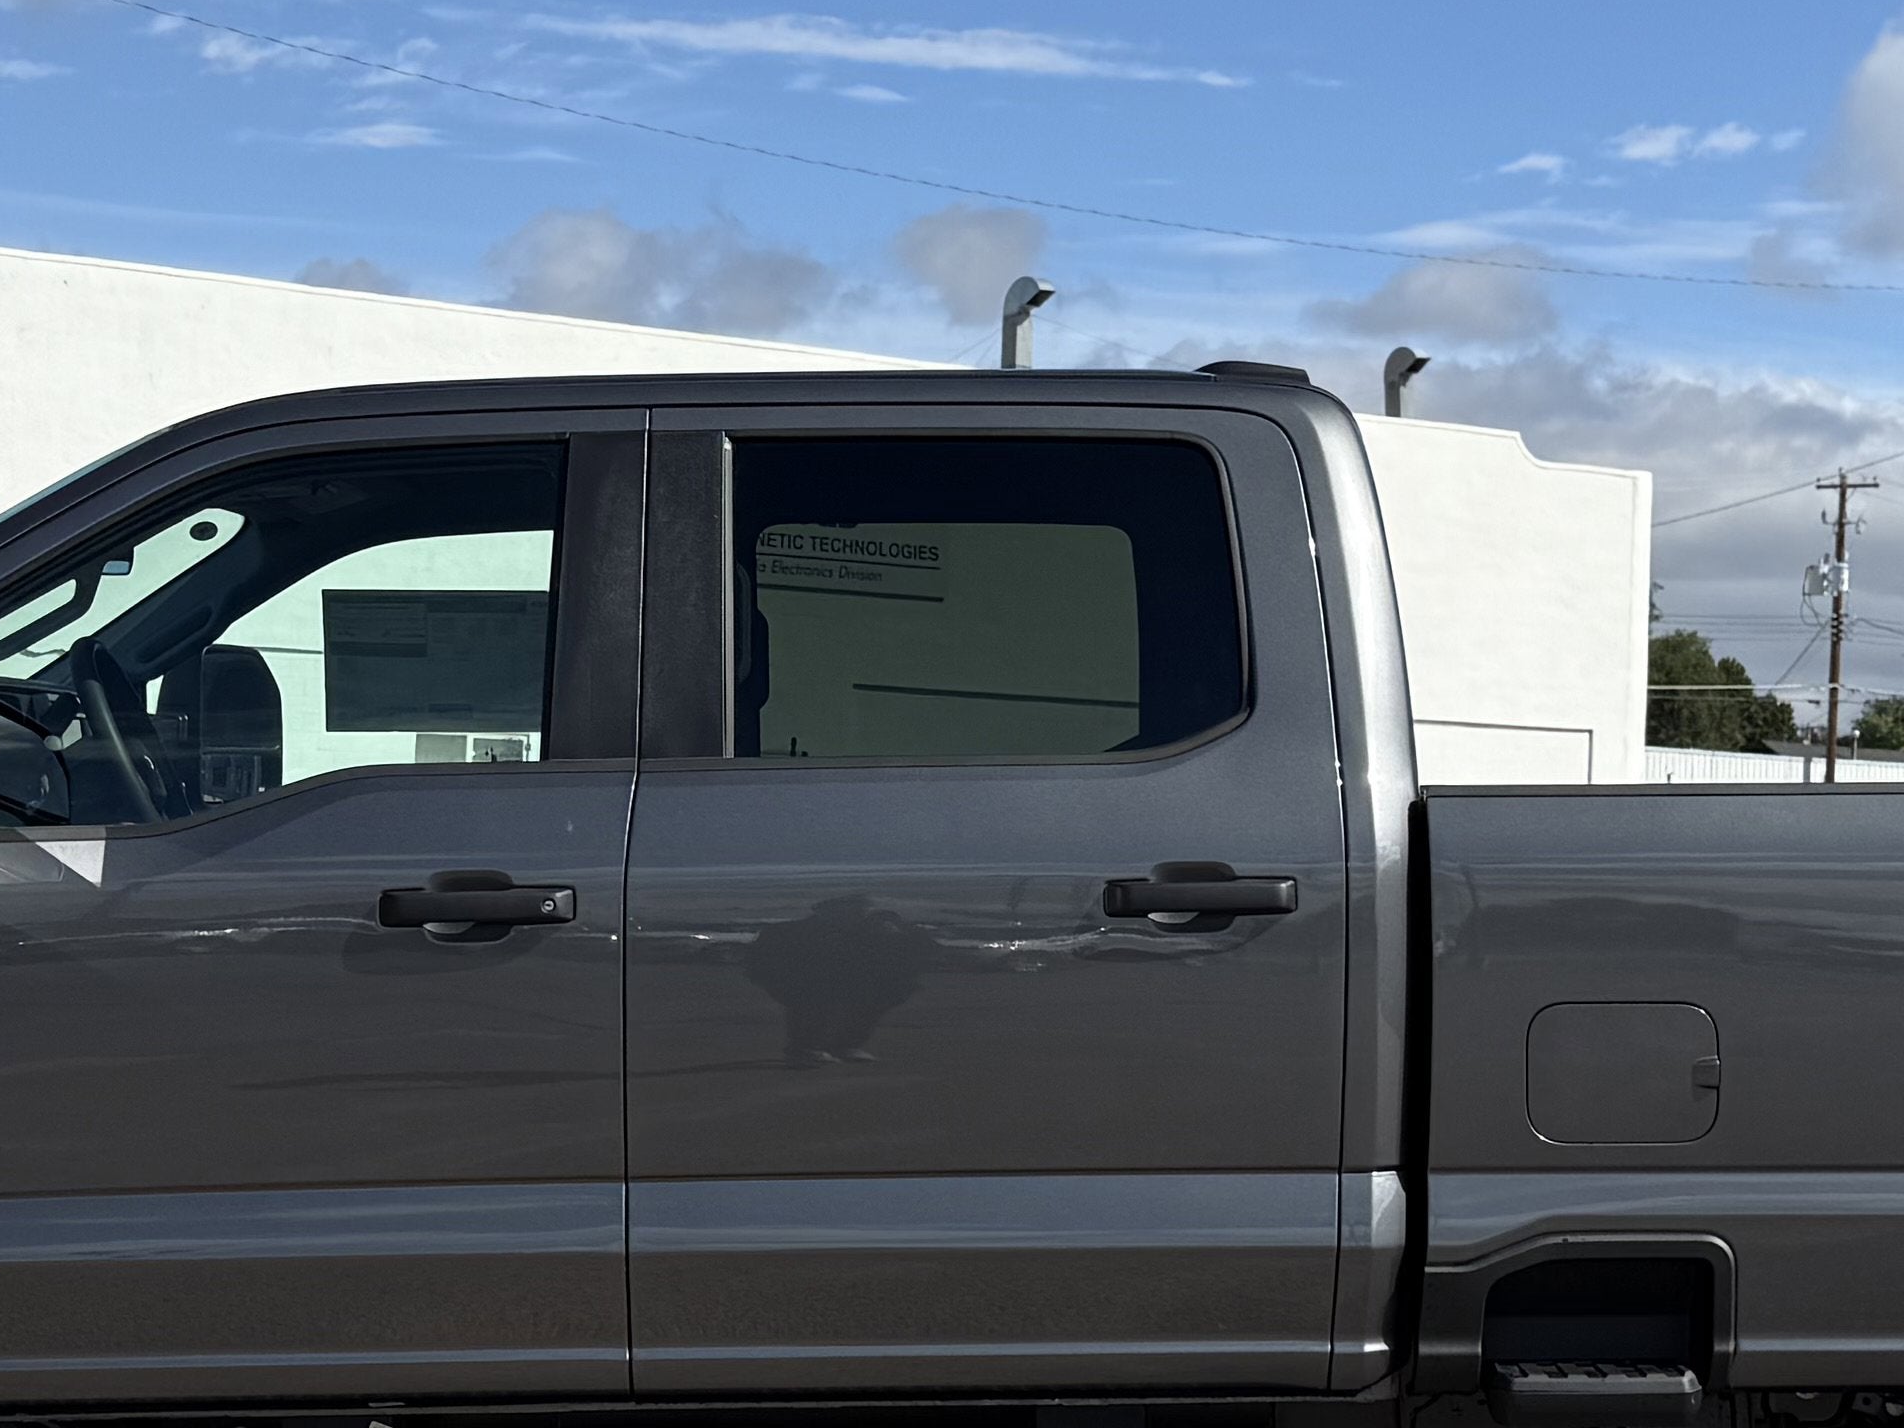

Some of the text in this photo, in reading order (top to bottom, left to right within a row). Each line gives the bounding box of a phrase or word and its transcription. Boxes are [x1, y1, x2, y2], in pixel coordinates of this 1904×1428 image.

[809, 535, 940, 562] TECHNOLOGIES
[771, 558, 833, 580] Electronics
[838, 564, 883, 582] Division
